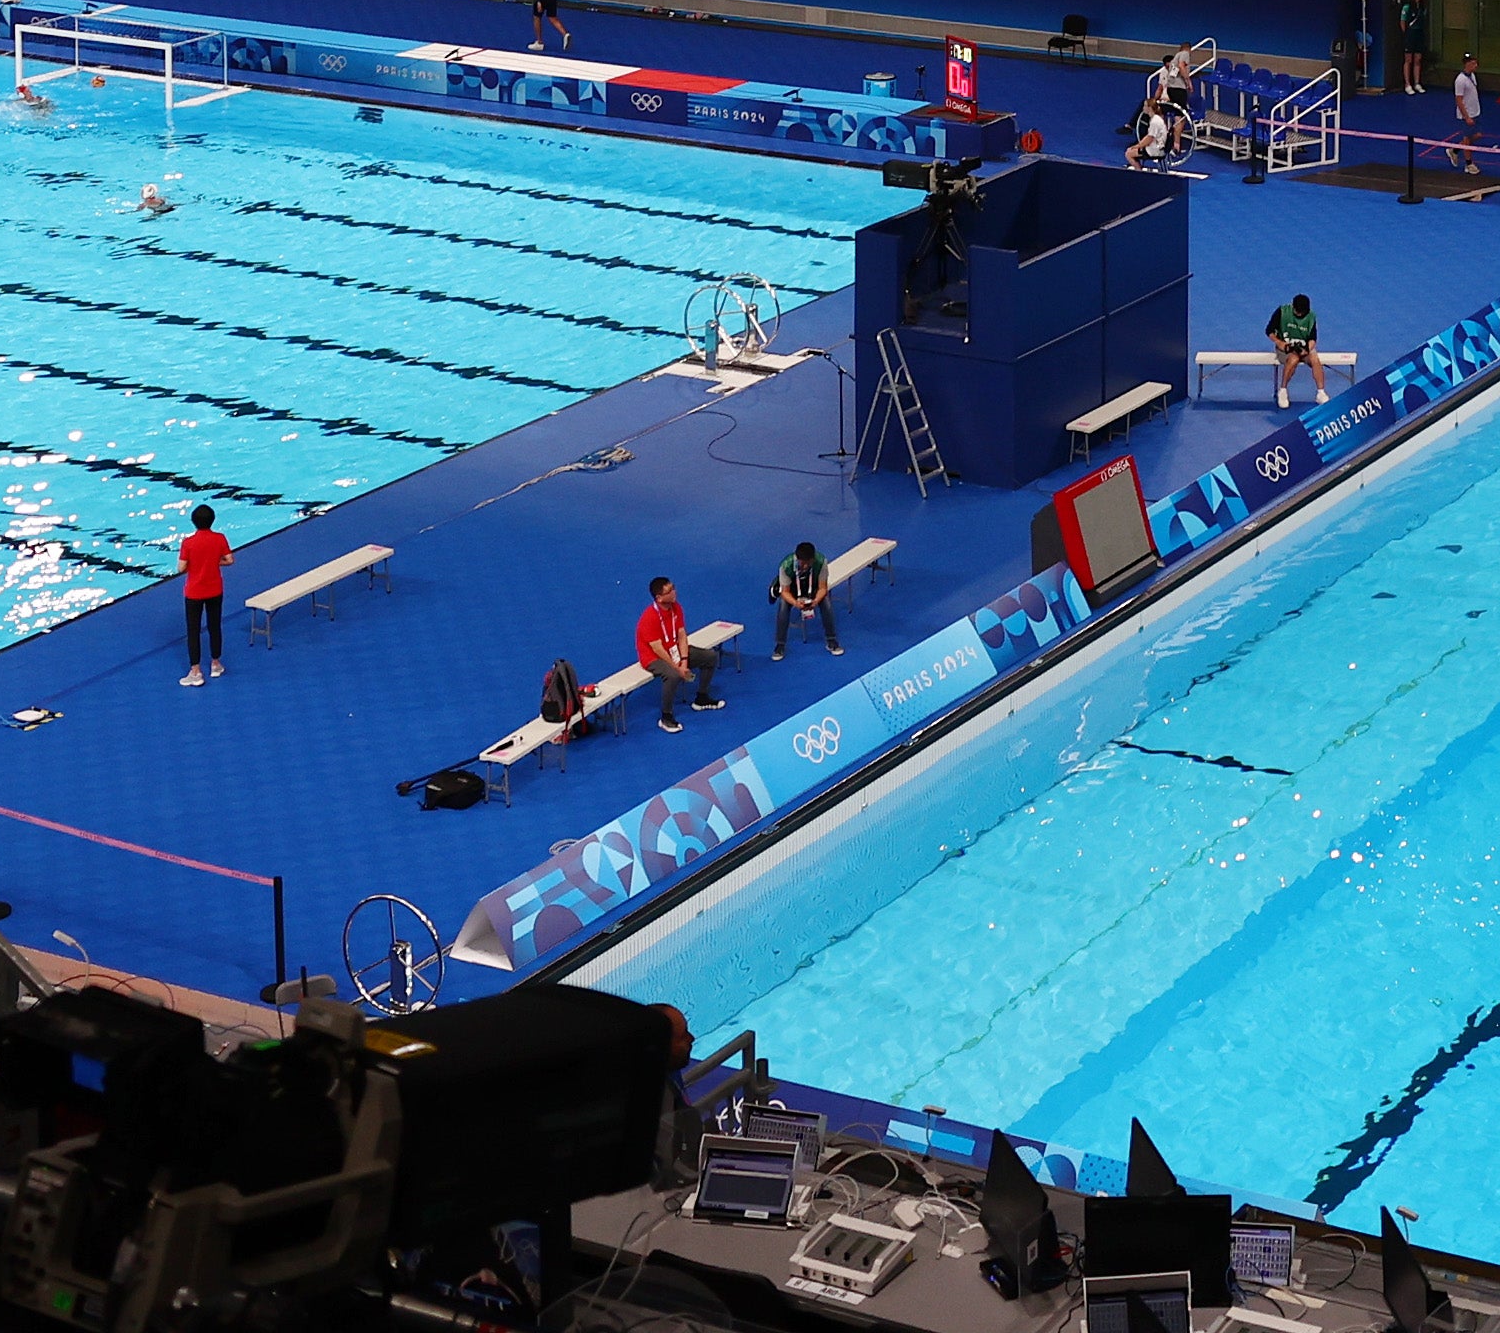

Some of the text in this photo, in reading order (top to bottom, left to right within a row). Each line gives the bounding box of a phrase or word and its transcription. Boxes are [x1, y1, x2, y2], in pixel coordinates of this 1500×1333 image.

[733, 109, 765, 123] 2024
[951, 101, 972, 114] OMEGA
[1350, 397, 1382, 424] 2024
[933, 645, 978, 681] 2024
